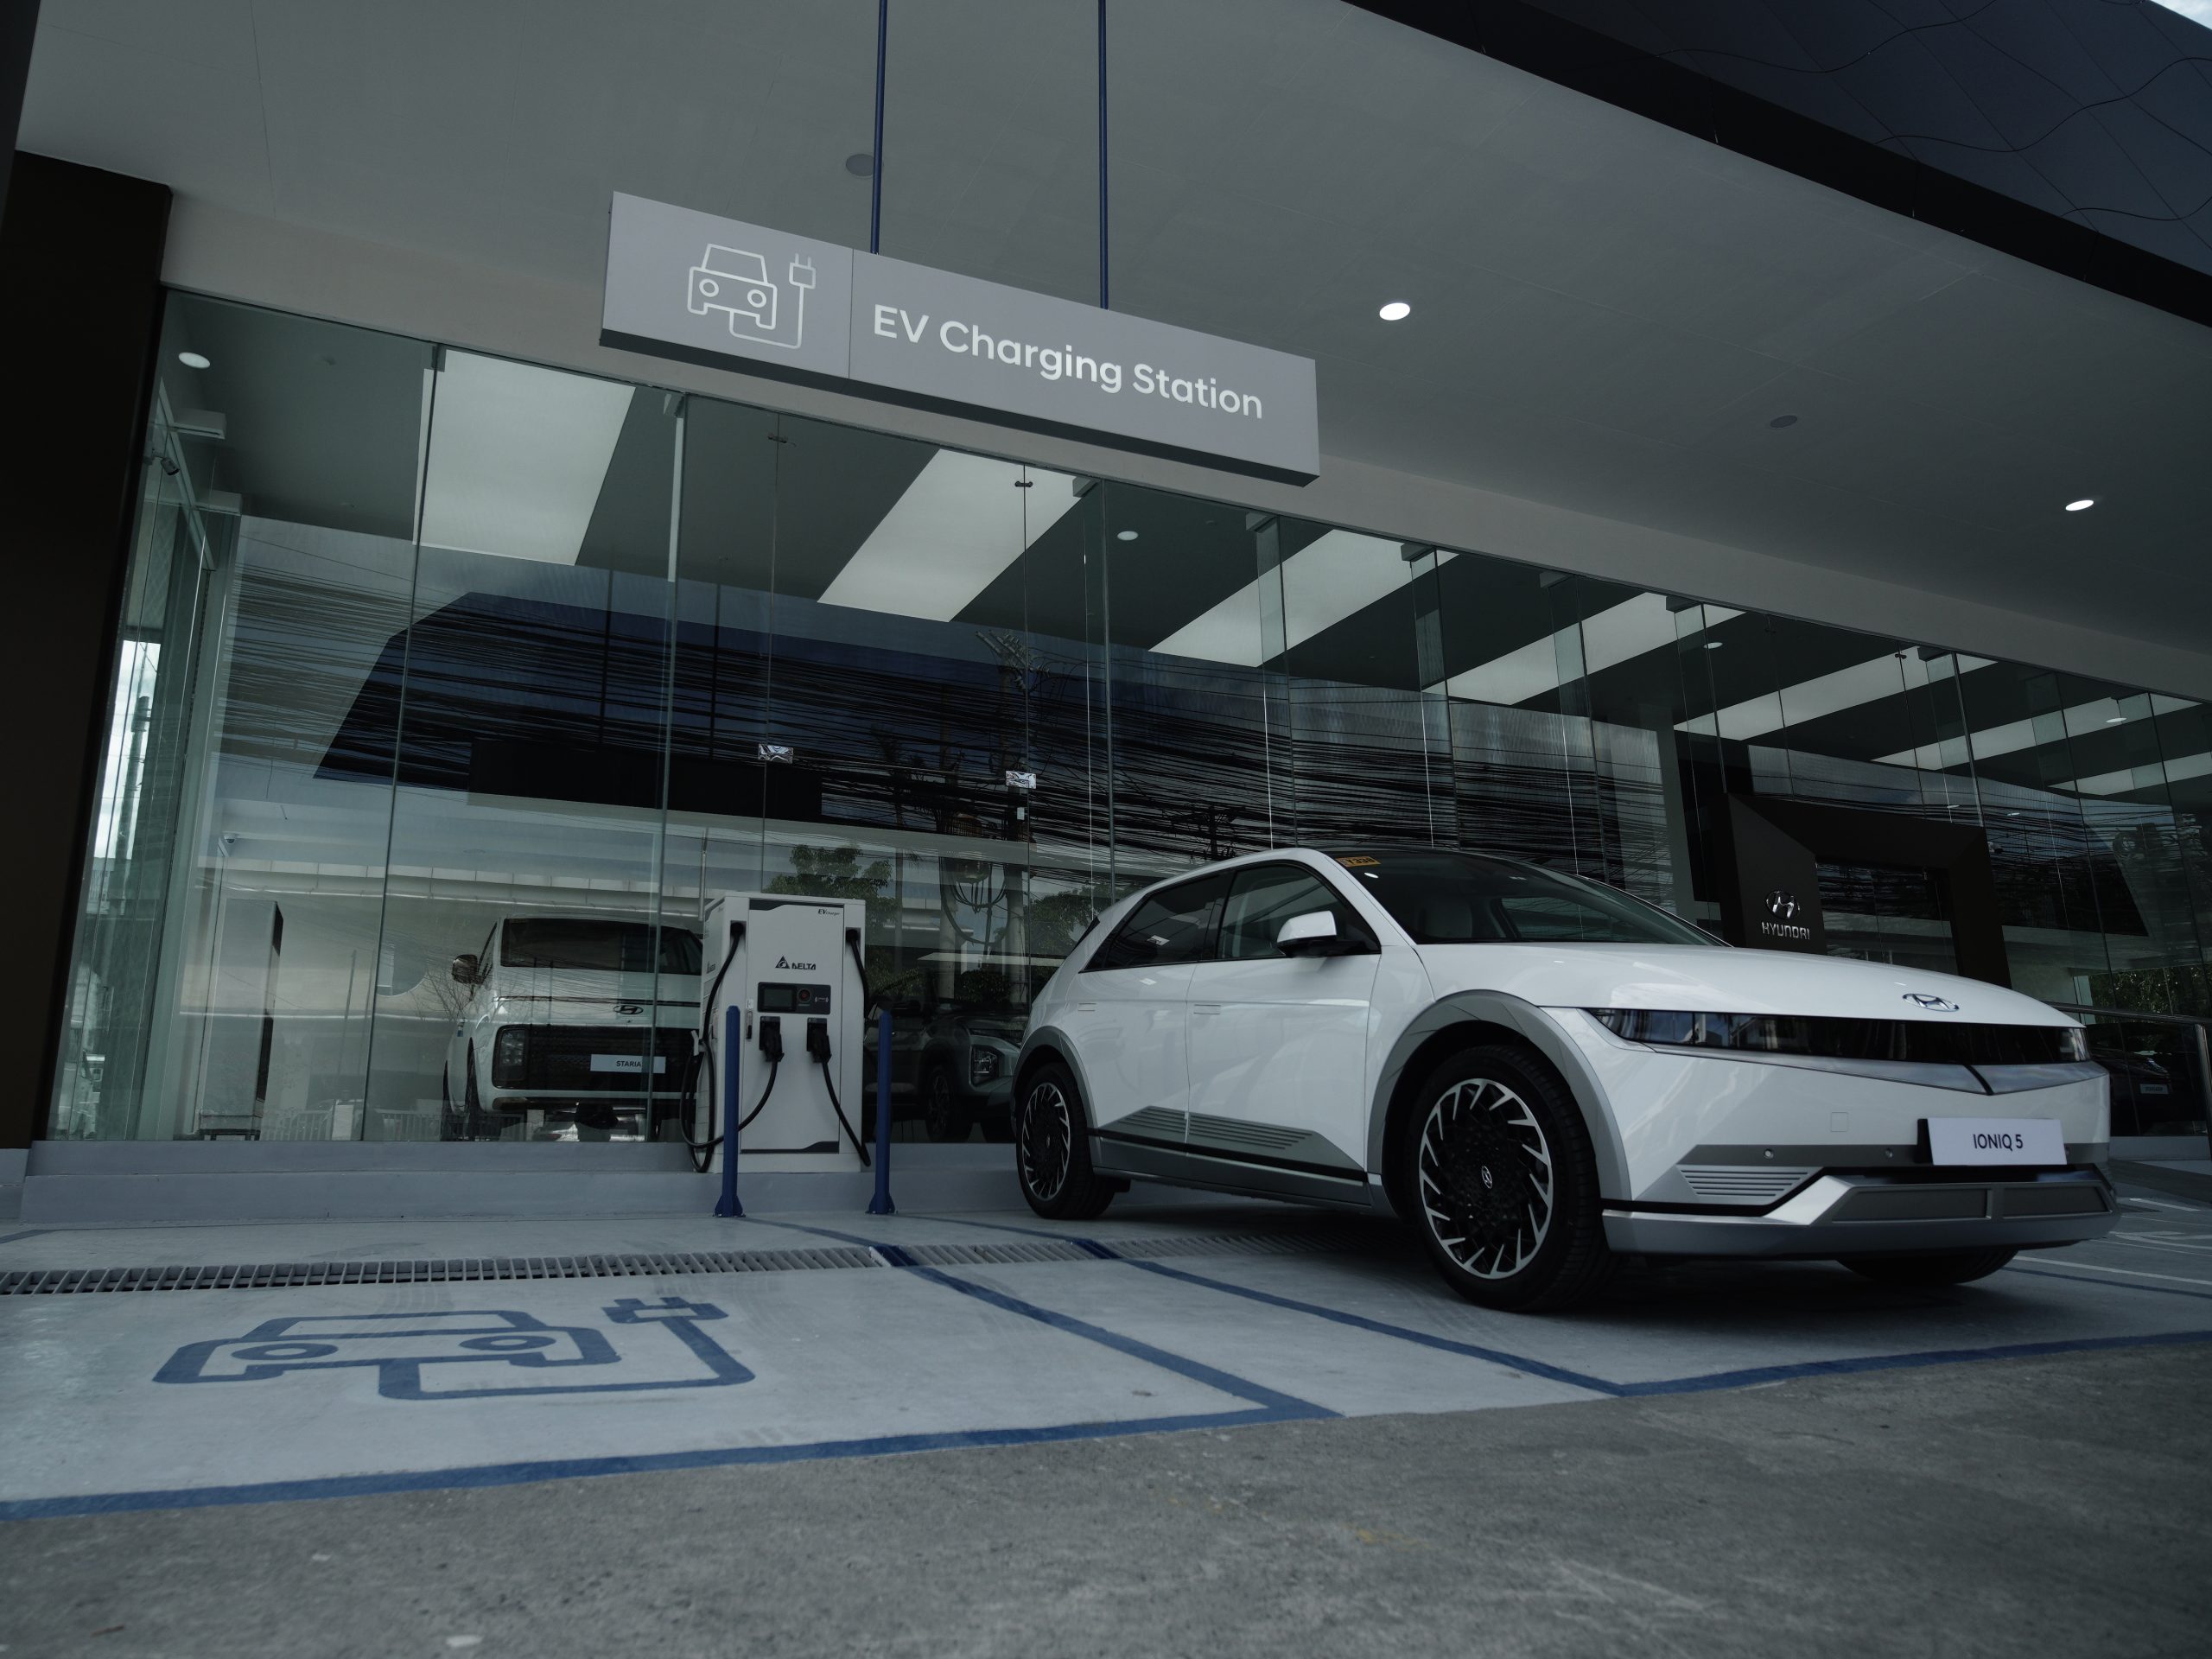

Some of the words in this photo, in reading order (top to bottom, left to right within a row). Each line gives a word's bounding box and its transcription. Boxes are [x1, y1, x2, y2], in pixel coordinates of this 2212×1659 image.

[874, 303, 930, 343] EV
[939, 320, 1122, 393] Charging
[1132, 363, 1262, 419] Station
[1761, 921, 1811, 940] HYUNDAI
[1973, 1134, 2013, 1152] IONIQ
[2015, 1134, 2024, 1149] 5
